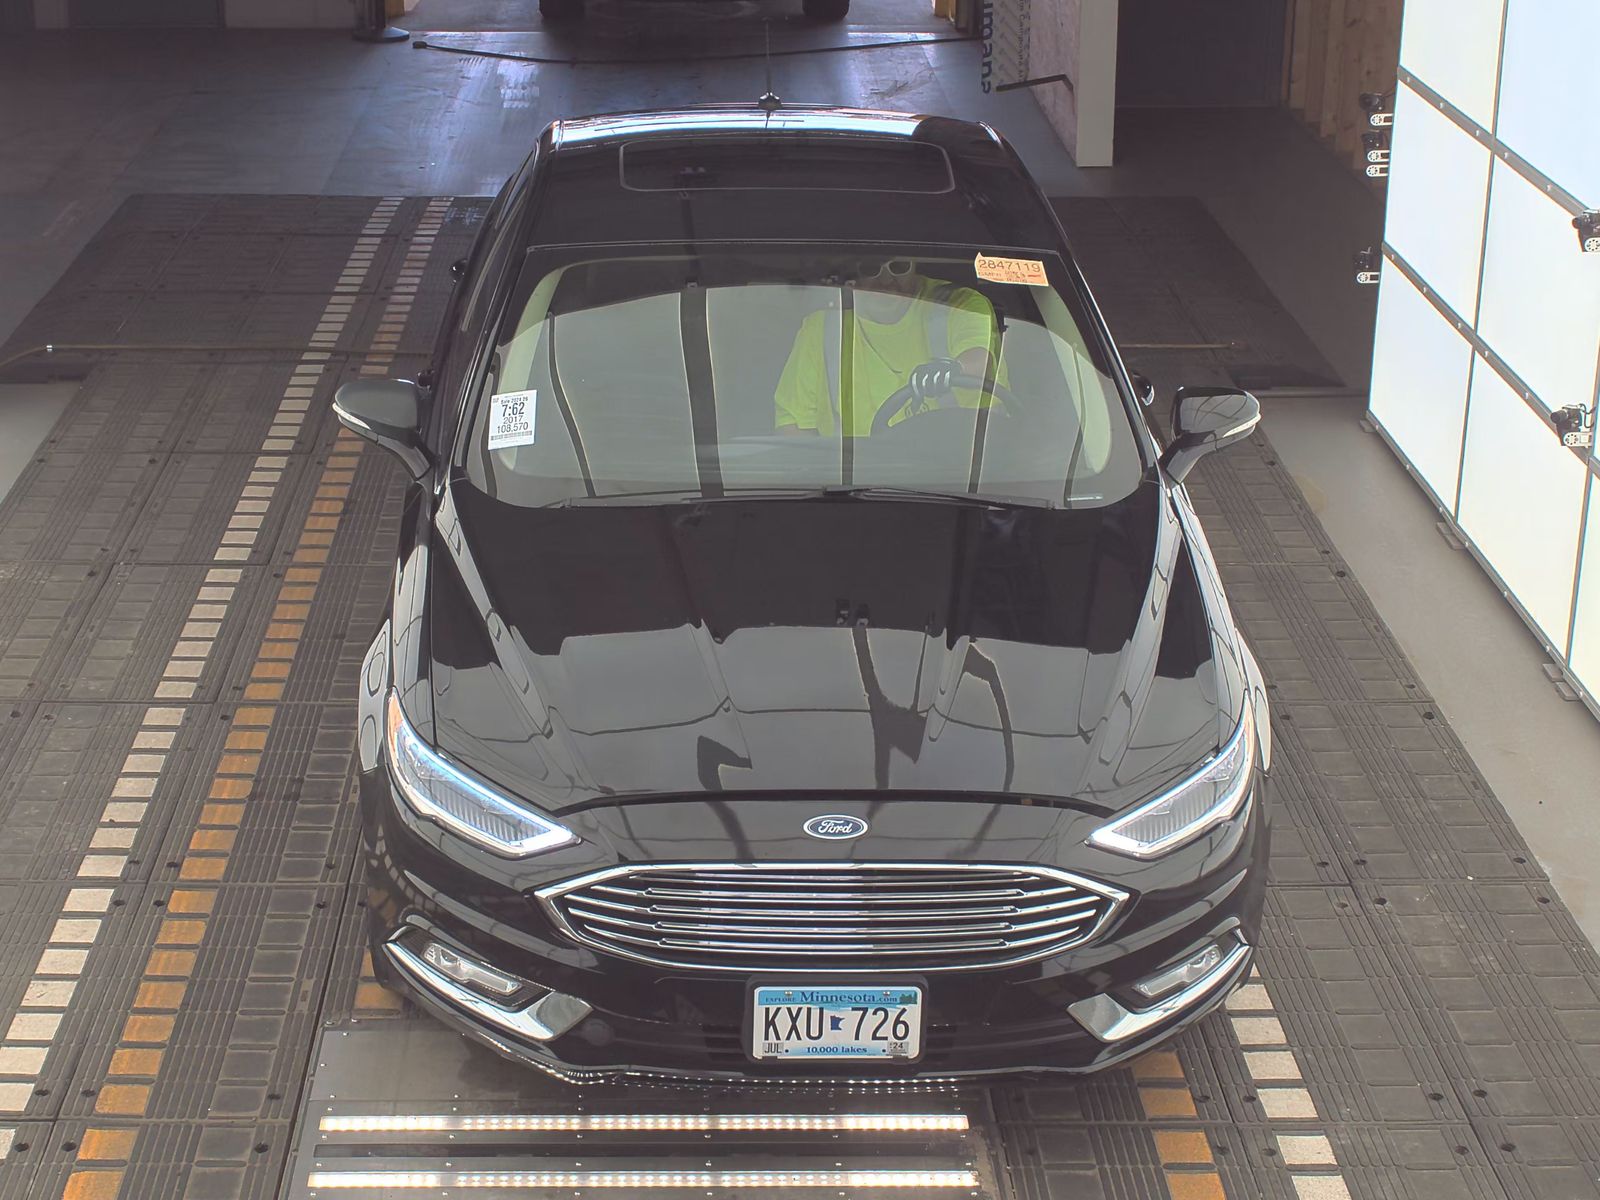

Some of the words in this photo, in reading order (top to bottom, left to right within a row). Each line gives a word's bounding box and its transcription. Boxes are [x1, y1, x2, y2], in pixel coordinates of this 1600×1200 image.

[979, 259, 1041, 273] 2847119
[502, 401, 525, 417] 7:62
[503, 415, 524, 424] 2017
[817, 819, 853, 834] Ford
[763, 1006, 825, 1041] KXU
[851, 1006, 910, 1041] 726
[764, 1042, 783, 1054] JUL
[806, 1046, 838, 1054] 10,000
[841, 1045, 868, 1053] lakes
